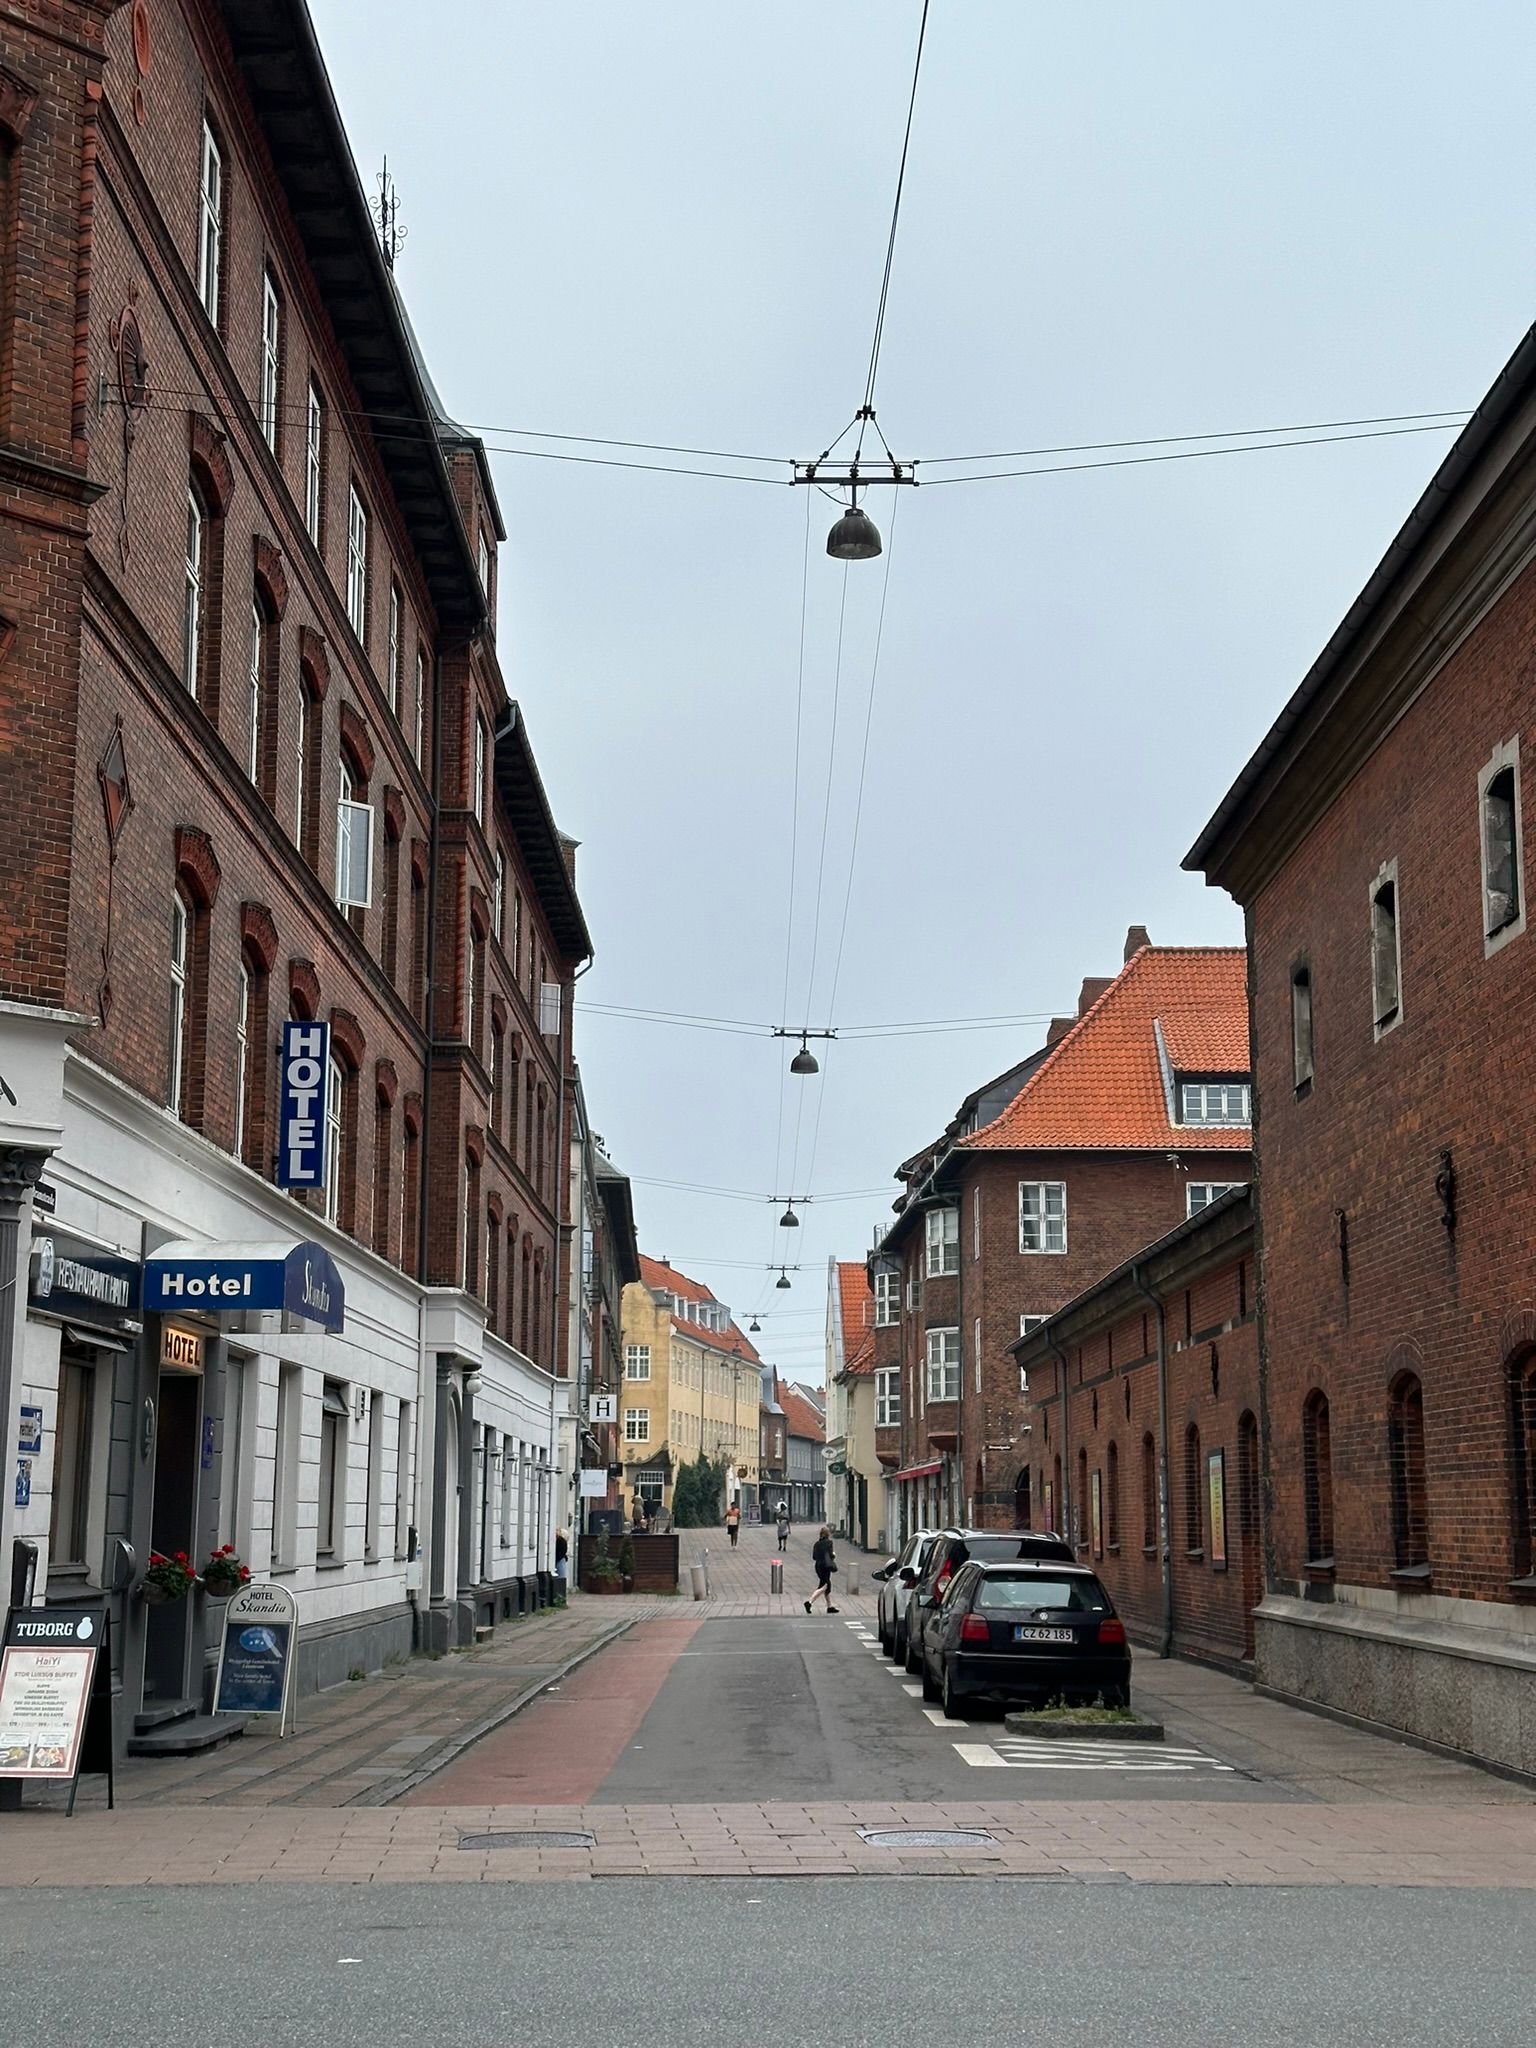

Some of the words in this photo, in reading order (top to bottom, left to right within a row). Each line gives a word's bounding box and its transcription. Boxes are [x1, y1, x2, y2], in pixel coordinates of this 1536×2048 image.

[287, 1028, 321, 1179] HOTEL
[57, 1258, 109, 1301] RESTAURANT
[161, 1273, 252, 1296] Hotel
[165, 1331, 200, 1366] HOTEL
[596, 1401, 610, 1417] H
[250, 1592, 274, 1600] HOTEL
[236, 1599, 286, 1613] Skandia
[17, 1623, 74, 1636] TUBORG
[1023, 1628, 1036, 1638] CZ
[1039, 1629, 1050, 1639] 62
[1054, 1630, 1071, 1640] 185
